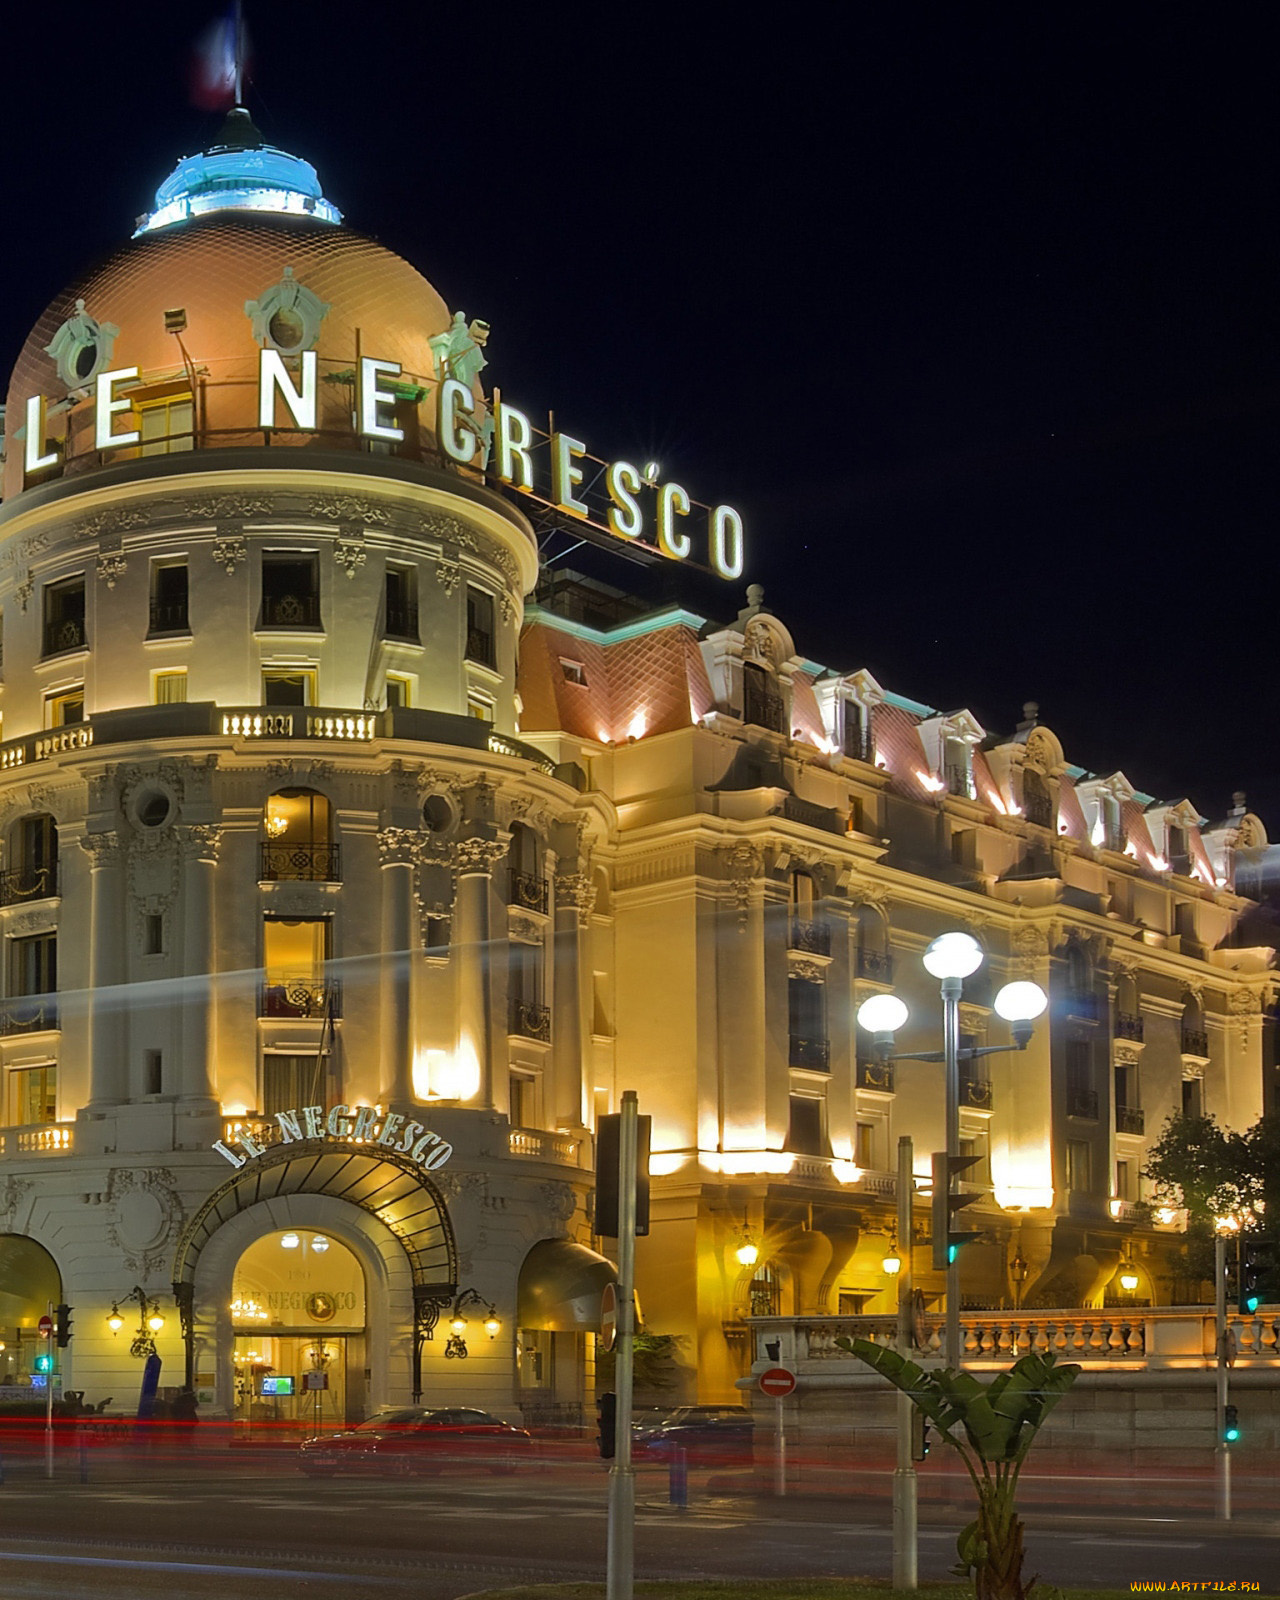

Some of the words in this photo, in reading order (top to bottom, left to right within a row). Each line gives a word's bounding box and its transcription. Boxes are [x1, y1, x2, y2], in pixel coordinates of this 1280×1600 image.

[25, 367, 140, 474] LE
[260, 348, 743, 580] NEGRESCO
[212, 1126, 266, 1168] LE
[275, 1105, 453, 1170] NEGRESCO
